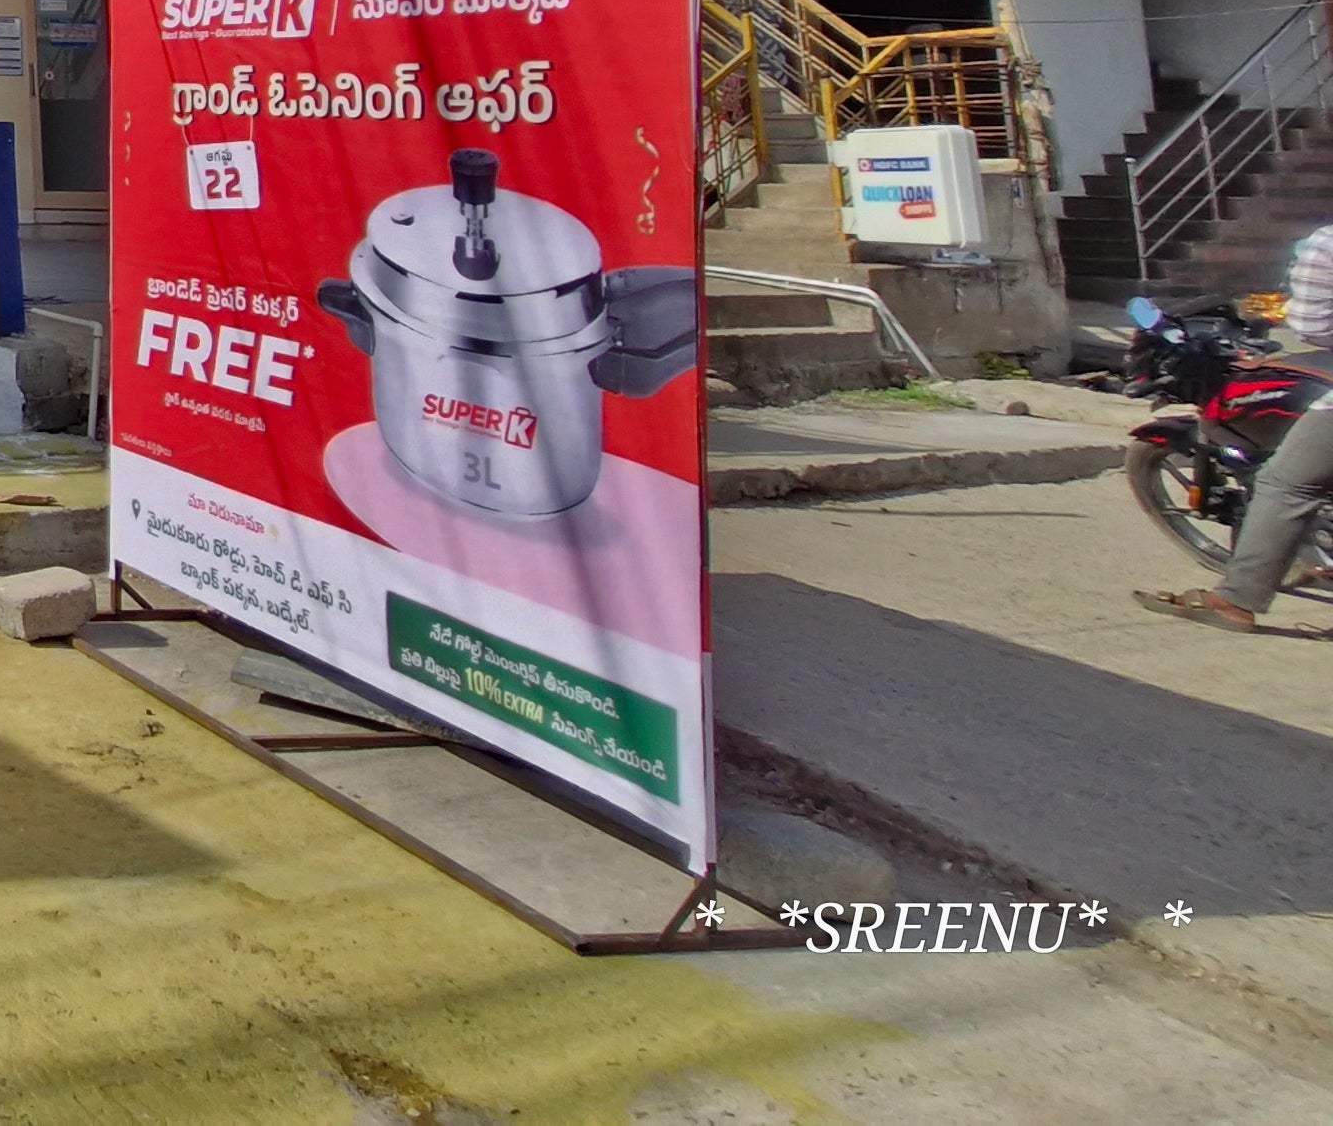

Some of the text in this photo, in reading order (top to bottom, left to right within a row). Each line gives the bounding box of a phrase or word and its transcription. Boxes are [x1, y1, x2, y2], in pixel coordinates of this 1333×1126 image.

[215, 25, 269, 38] Guaranteed
[173, 60, 554, 133] గ్రాండ్ ఓపెనింగ్ ఆఫర్
[204, 167, 243, 200] 22
[147, 277, 202, 302] బ్రాండెడ్
[252, 293, 299, 328] కుక్కర్
[463, 452, 501, 490] 3L
[187, 493, 265, 535] మా చిరునామా
[147, 510, 210, 552] మైదుకూరు
[251, 554, 285, 586] హెచ్
[180, 561, 220, 591] బ్యాంక్
[464, 666, 502, 705] 10%
[503, 689, 545, 724] EXTRA
